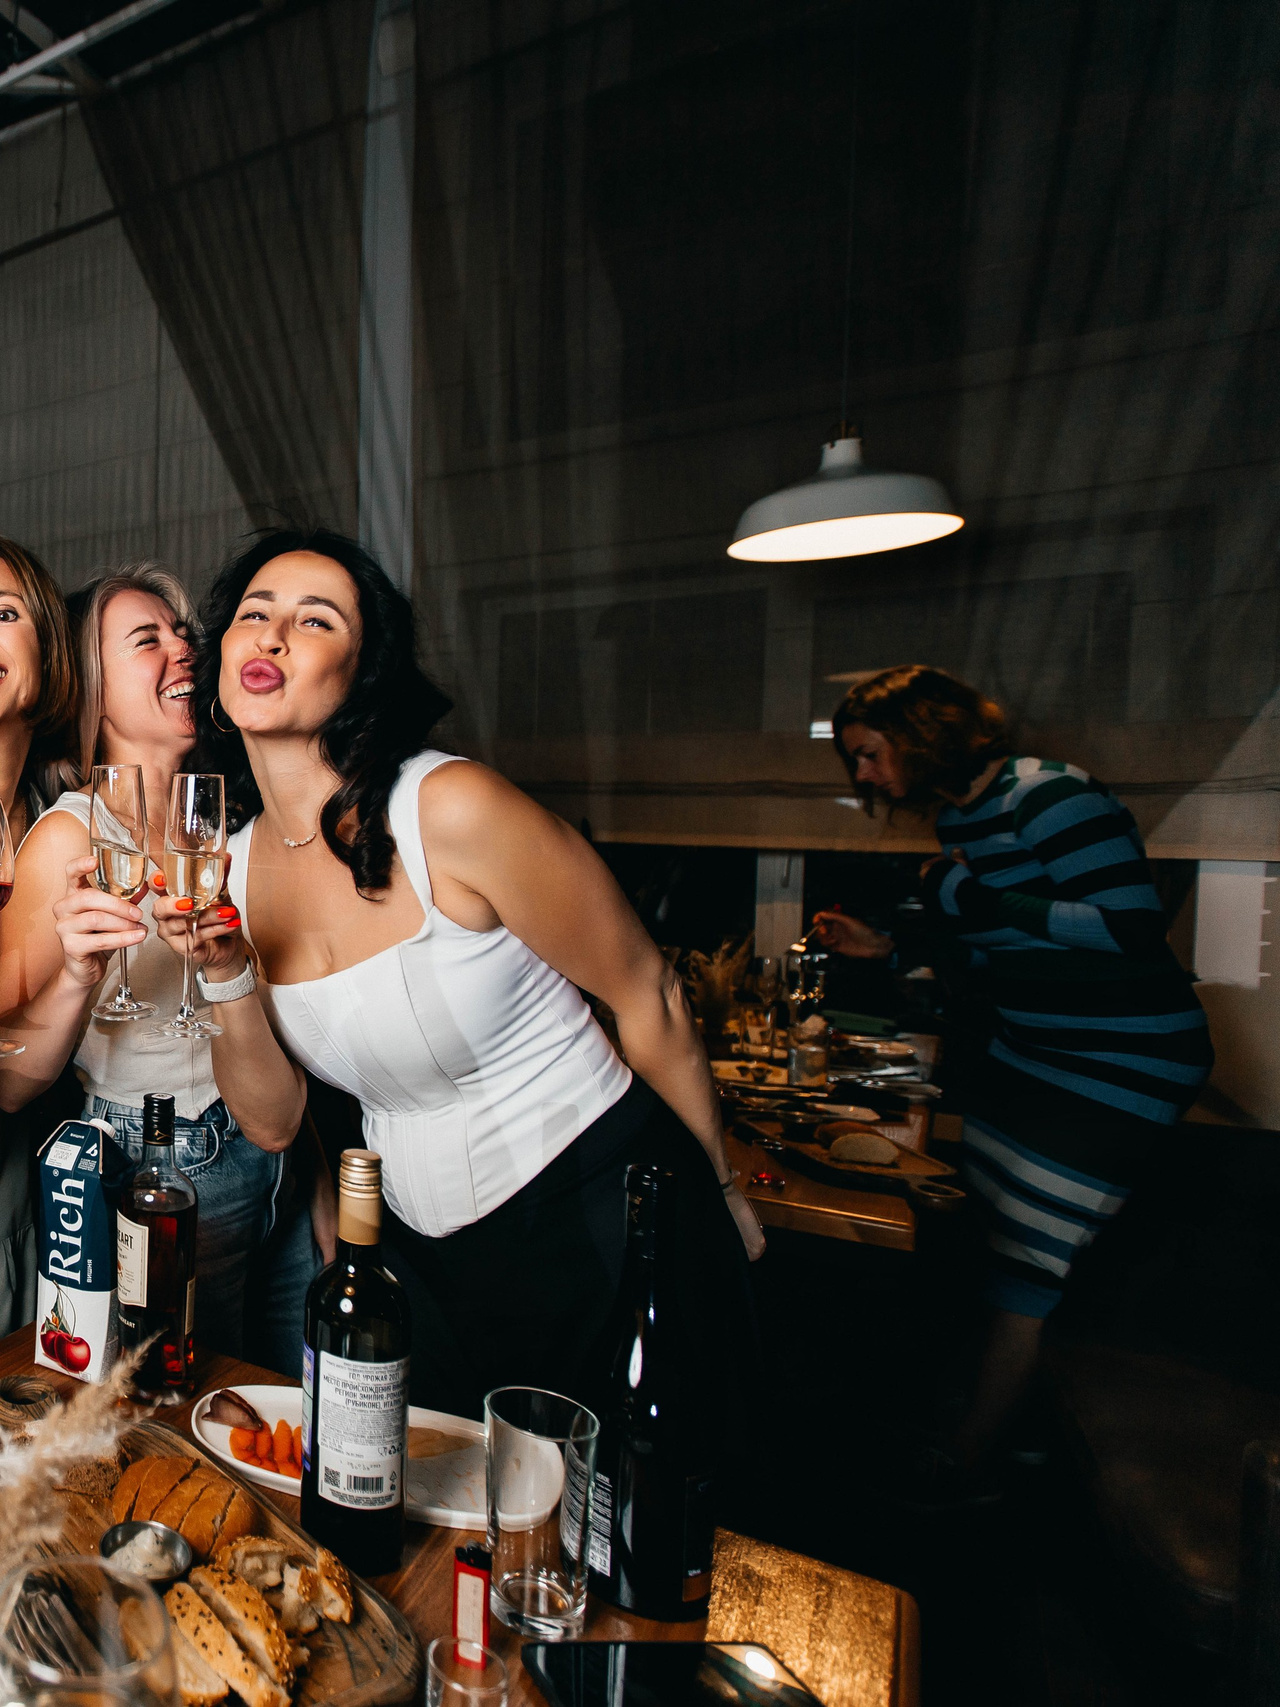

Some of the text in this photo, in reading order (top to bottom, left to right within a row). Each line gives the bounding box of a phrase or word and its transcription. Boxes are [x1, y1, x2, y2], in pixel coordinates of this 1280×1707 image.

[49, 1178, 85, 1285] Rich
[323, 1374, 341, 1387] МЕСТО
[341, 1381, 392, 1394] ПРОИСХОЖДЕНИЯ
[363, 1374, 388, 1382] УРОЖАЯ
[334, 1387, 358, 1399] РЕГИОН
